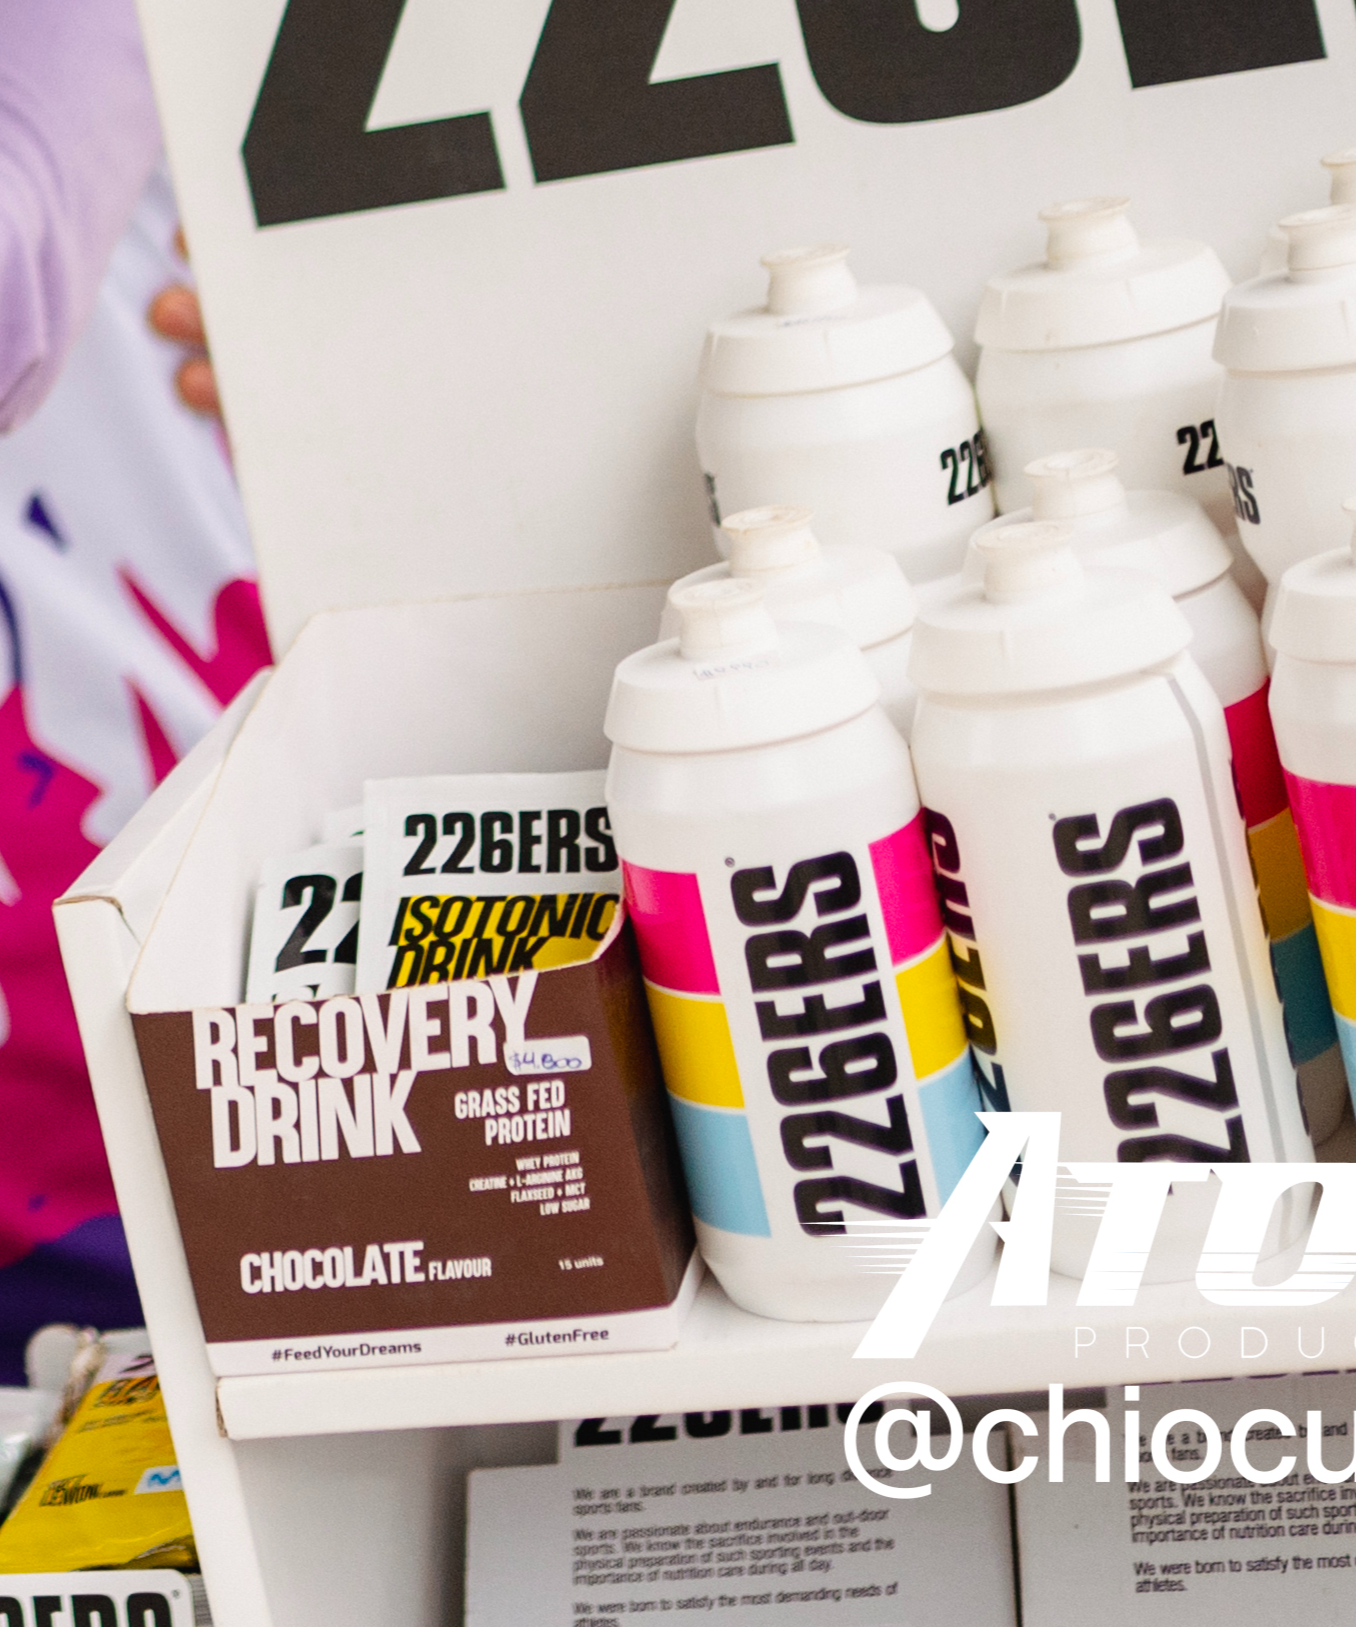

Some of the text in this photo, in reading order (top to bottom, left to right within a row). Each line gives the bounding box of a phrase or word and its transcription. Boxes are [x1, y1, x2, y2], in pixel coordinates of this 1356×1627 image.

[403, 806, 619, 876] 226ERS
[388, 892, 621, 946] ISOTONIC
[386, 936, 550, 991] DRINK
[192, 970, 538, 1090] RECOVERY
[729, 850, 927, 1236] 226ERS
[454, 1079, 565, 1119] GRASS FED
[211, 1069, 422, 1169] DRINK
[484, 1108, 571, 1146] PROTEIN
[515, 1151, 580, 1171] WHEY PROTEIN
[510, 1188, 554, 1203] FLAXSEED
[540, 1197, 591, 1216] LOW SUGAR
[240, 1240, 492, 1294] CHOCOLATE FLAVOUR
[558, 1254, 604, 1271] 15 units
[505, 1327, 610, 1347] #GlutenFree
[271, 1340, 422, 1363] #FeedYourDreams
[1129, 1495, 1178, 1511] sports.
[1182, 1493, 1205, 1508] We
[1209, 1491, 1247, 1507] know
[1250, 1490, 1272, 1505] the
[1277, 1487, 1336, 1503] sacrifice
[1130, 1504, 1319, 1529] physical preparation of such
[1132, 1522, 1319, 1546] importance of nutrition care
[1134, 1562, 1156, 1576] We
[1160, 1561, 1192, 1575] were
[1229, 1557, 1242, 1573] to
[1292, 1555, 1313, 1570] the
[1317, 1553, 1352, 1569] most
